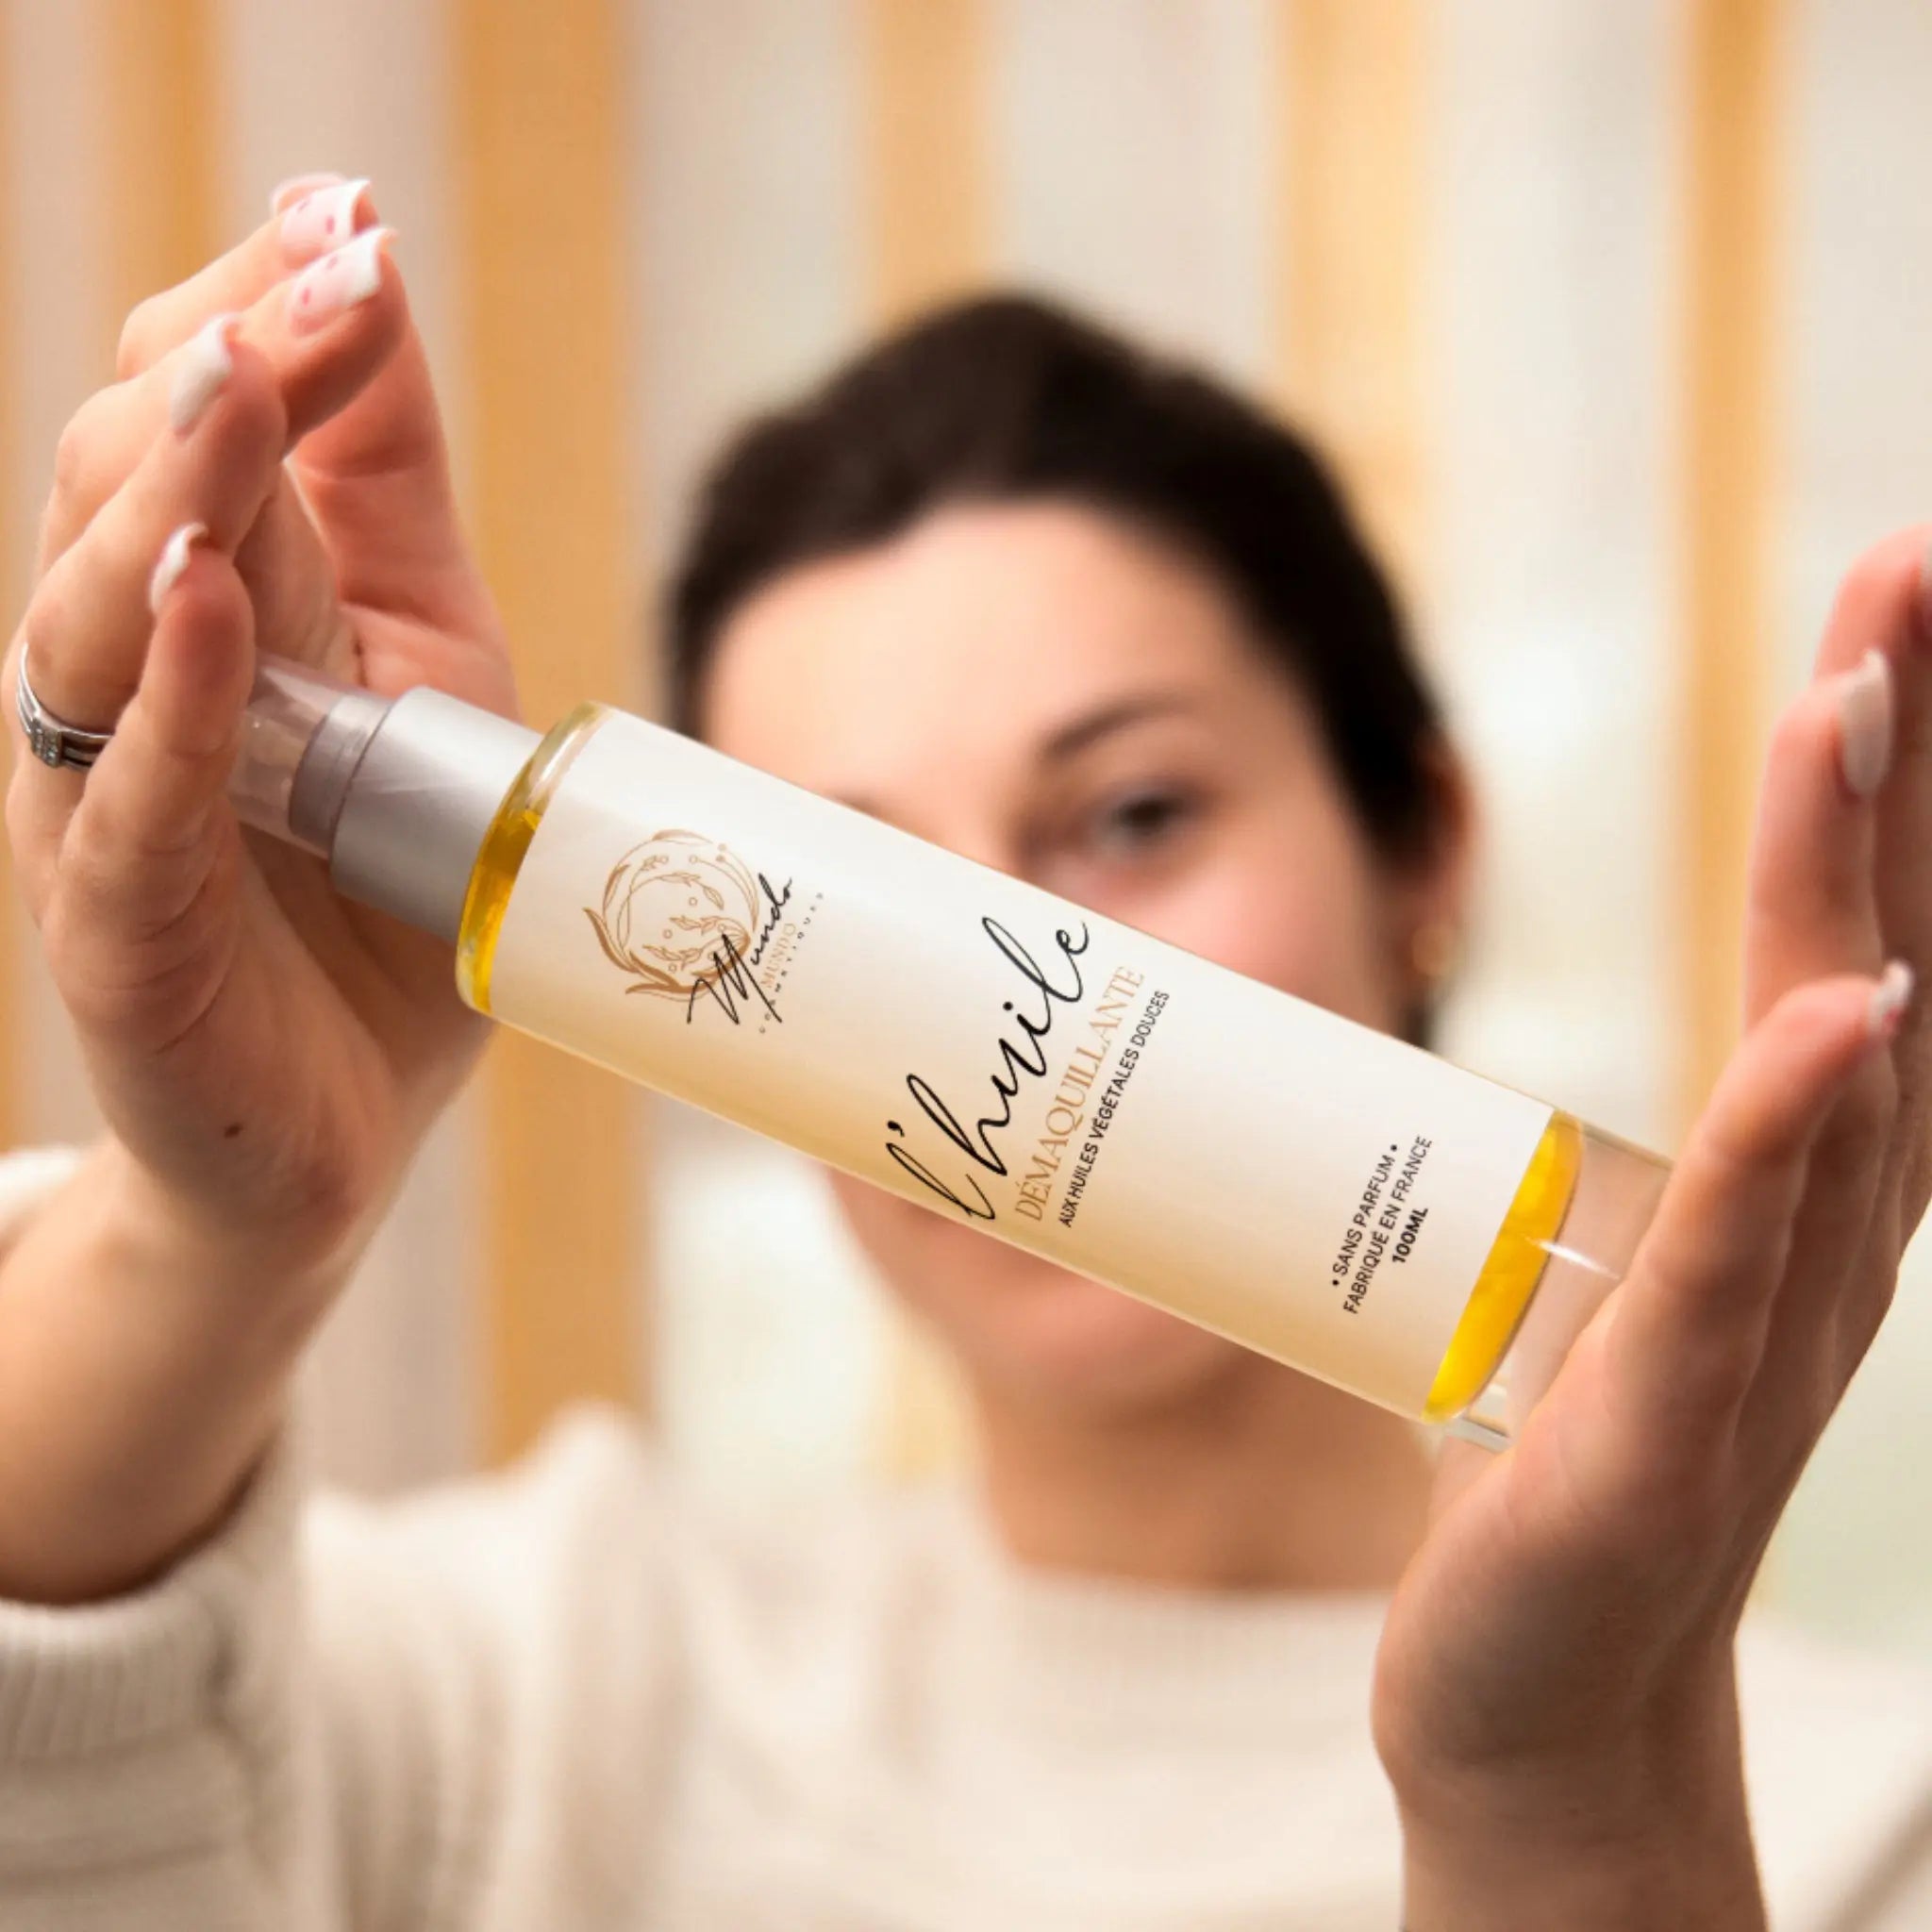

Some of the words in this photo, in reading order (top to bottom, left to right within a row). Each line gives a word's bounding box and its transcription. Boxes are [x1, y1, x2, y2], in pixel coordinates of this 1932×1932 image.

[687, 873, 792, 1025] Mundo
[760, 922, 796, 990] MUNDO
[1015, 966, 1144, 1221] DÉMAQUILLANTE
[1058, 1199, 1077, 1227] AUX
[1068, 1141, 1099, 1200] HUILES
[1089, 1048, 1140, 1141] VÉGÉTALES
[1130, 990, 1170, 1049] DOUCES
[1332, 1228, 1363, 1275] SANS
[1353, 1154, 1395, 1227] PARFUM
[1342, 1230, 1390, 1314] FABRIQUÉ
[1378, 1204, 1402, 1230] EN
[1391, 1135, 1433, 1202] FRANCE
[1391, 1208, 1428, 1263] 100ML
